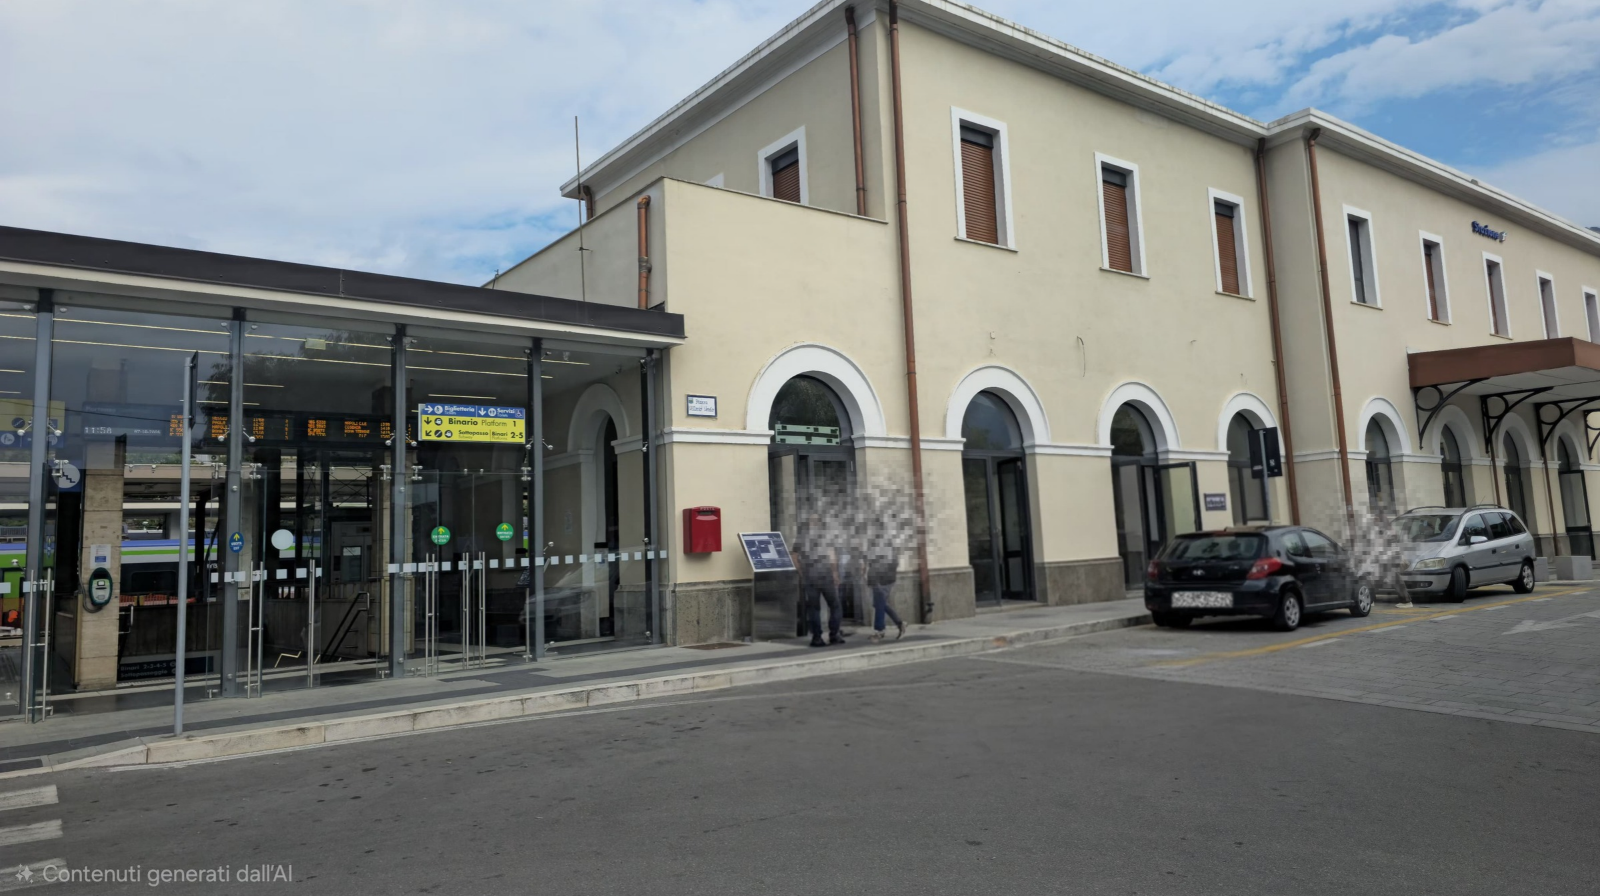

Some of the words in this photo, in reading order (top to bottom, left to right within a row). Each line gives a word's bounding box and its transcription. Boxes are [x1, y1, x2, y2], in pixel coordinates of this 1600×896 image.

[444, 405, 475, 413] Biglietteria
[448, 418, 478, 426] Binario
[481, 419, 508, 427] Platform
